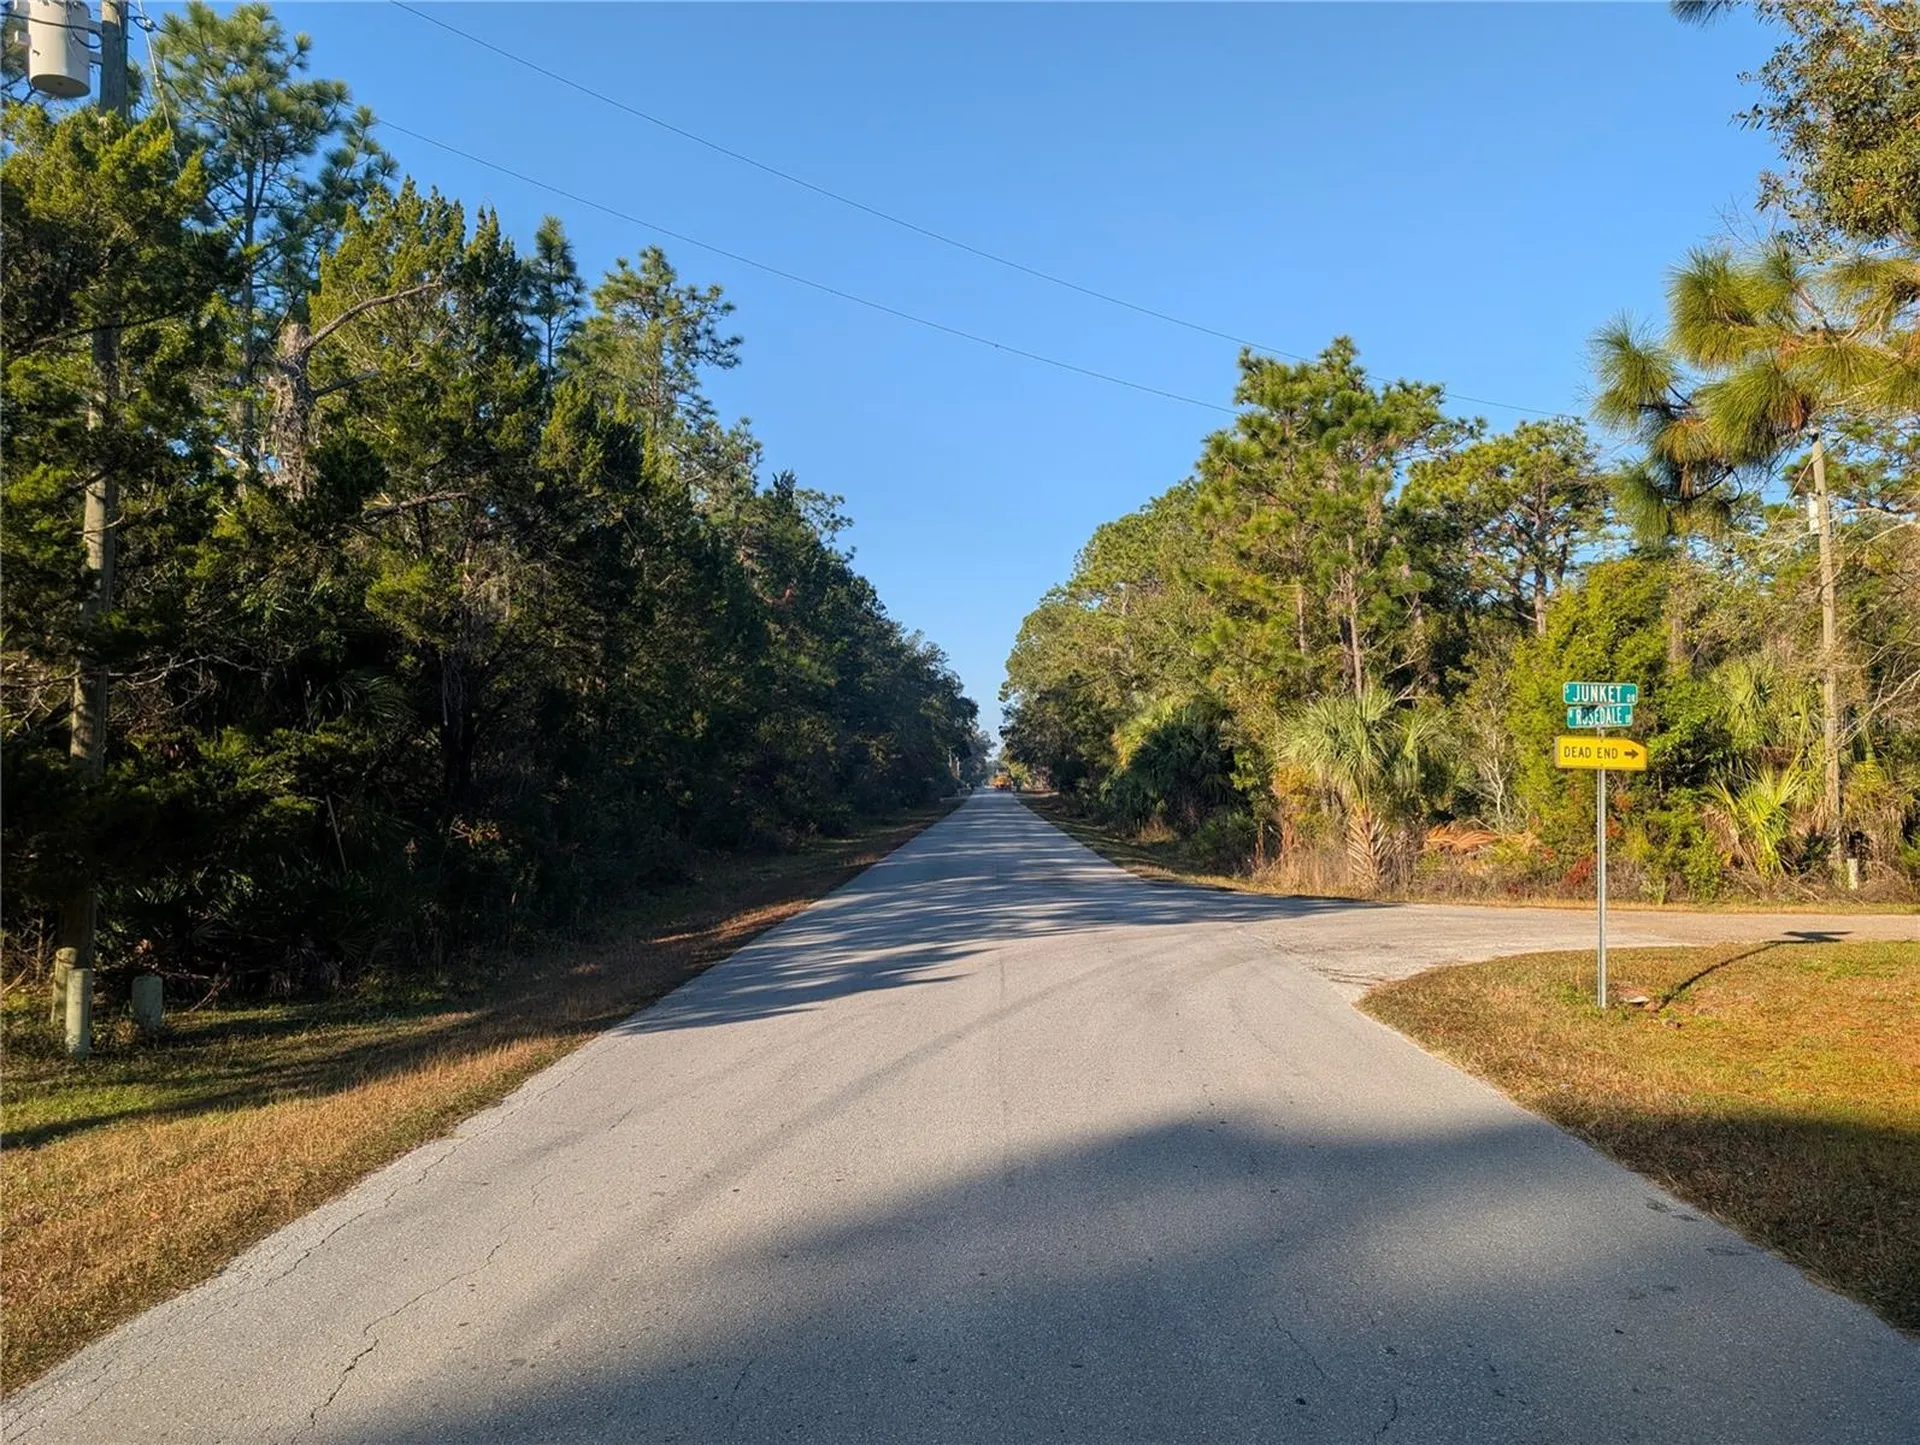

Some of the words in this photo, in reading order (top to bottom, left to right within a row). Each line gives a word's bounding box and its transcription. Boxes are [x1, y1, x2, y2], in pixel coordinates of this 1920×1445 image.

[1573, 685, 1622, 703] JUNKET
[1575, 706, 1622, 725] ROSEDALE
[1563, 746, 1592, 759] DEAD
[1596, 746, 1619, 760] END
